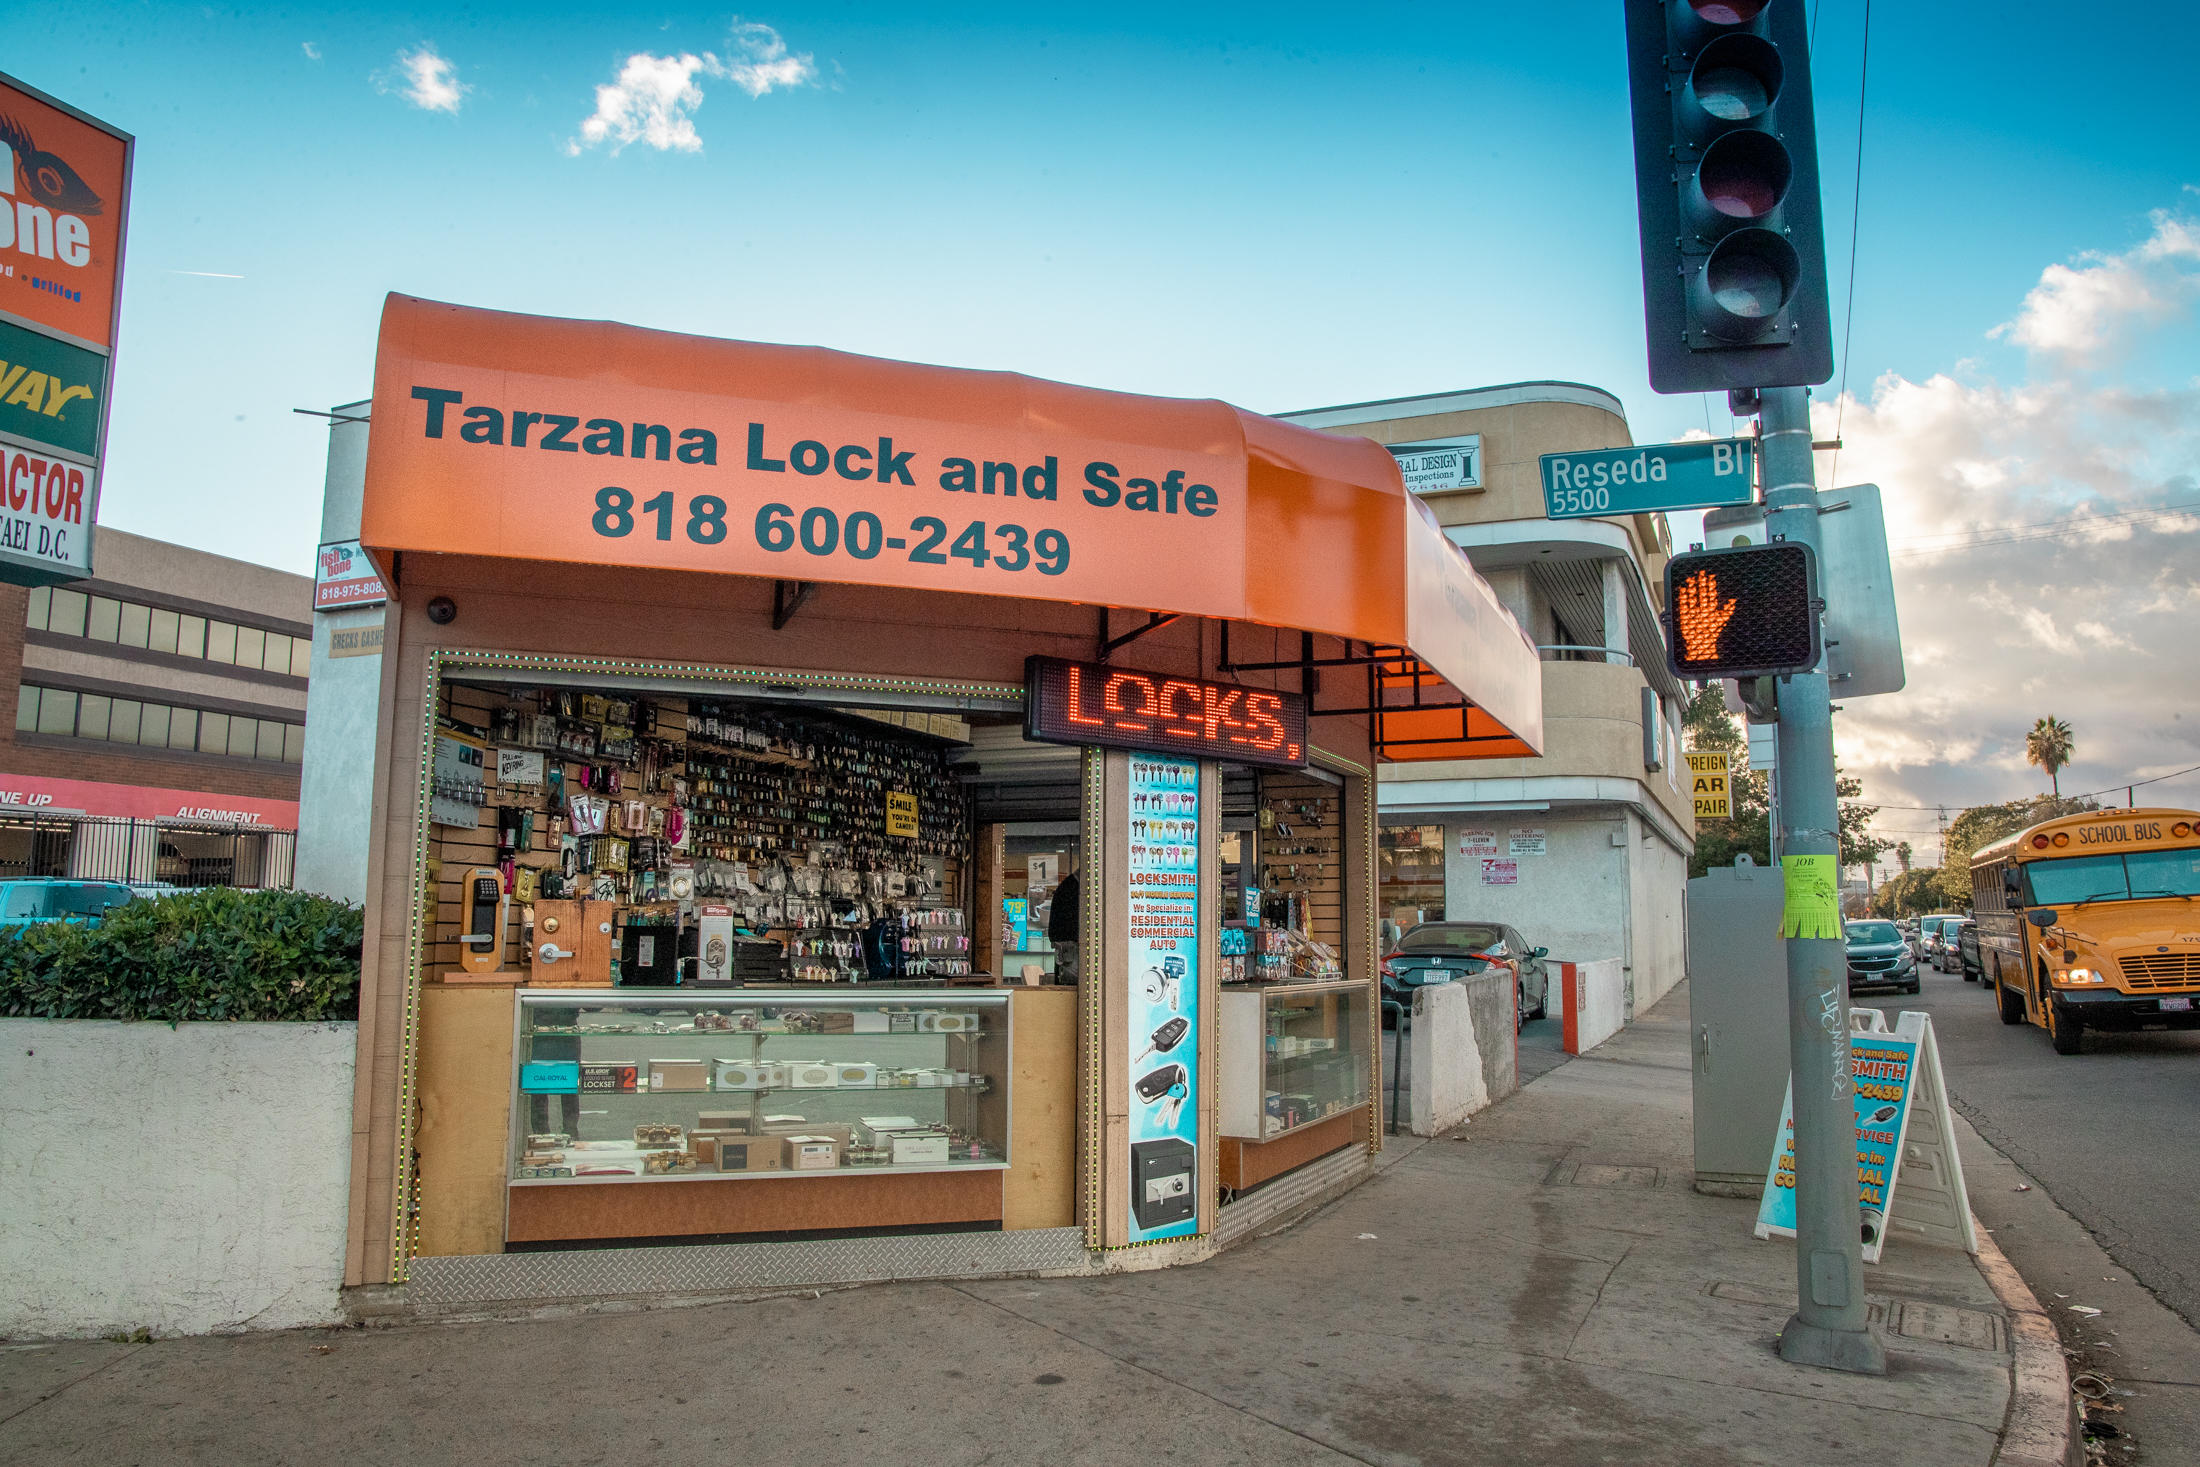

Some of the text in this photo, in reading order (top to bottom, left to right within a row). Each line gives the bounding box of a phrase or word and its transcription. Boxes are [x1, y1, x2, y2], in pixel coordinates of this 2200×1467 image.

[411, 386, 1218, 517] Tarzana Lock and Safe
[1421, 453, 1457, 471] DESIGN
[1551, 442, 1743, 490] Reseda Bl
[1405, 471, 1455, 484] Inspections
[1553, 487, 1610, 513] 5500
[591, 486, 1070, 577] 818 600-2439
[37, 524, 69, 560] D.C.
[333, 632, 359, 650] CHECKS
[27, 793, 53, 806] UP
[889, 799, 912, 812] SMILE
[176, 806, 261, 824] ALIGNMENT
[2079, 822, 2162, 844] SCHOOL BUS
[1032, 861, 1047, 879] $1
[1794, 858, 1814, 867] JOB
[1129, 873, 1197, 886] LOCKSMITH
[1133, 904, 1145, 912] We
[1146, 904, 1183, 914] Specialize
[1131, 916, 1195, 926] RESIDENTIAL
[1131, 928, 1195, 938] COMMERCIAL
[1150, 940, 1177, 950] AUTO
[1865, 1049, 1884, 1059] and
[1885, 1050, 1909, 1062] Safe
[583, 1080, 616, 1088] LOCKSET
[623, 1067, 636, 1088] 2
